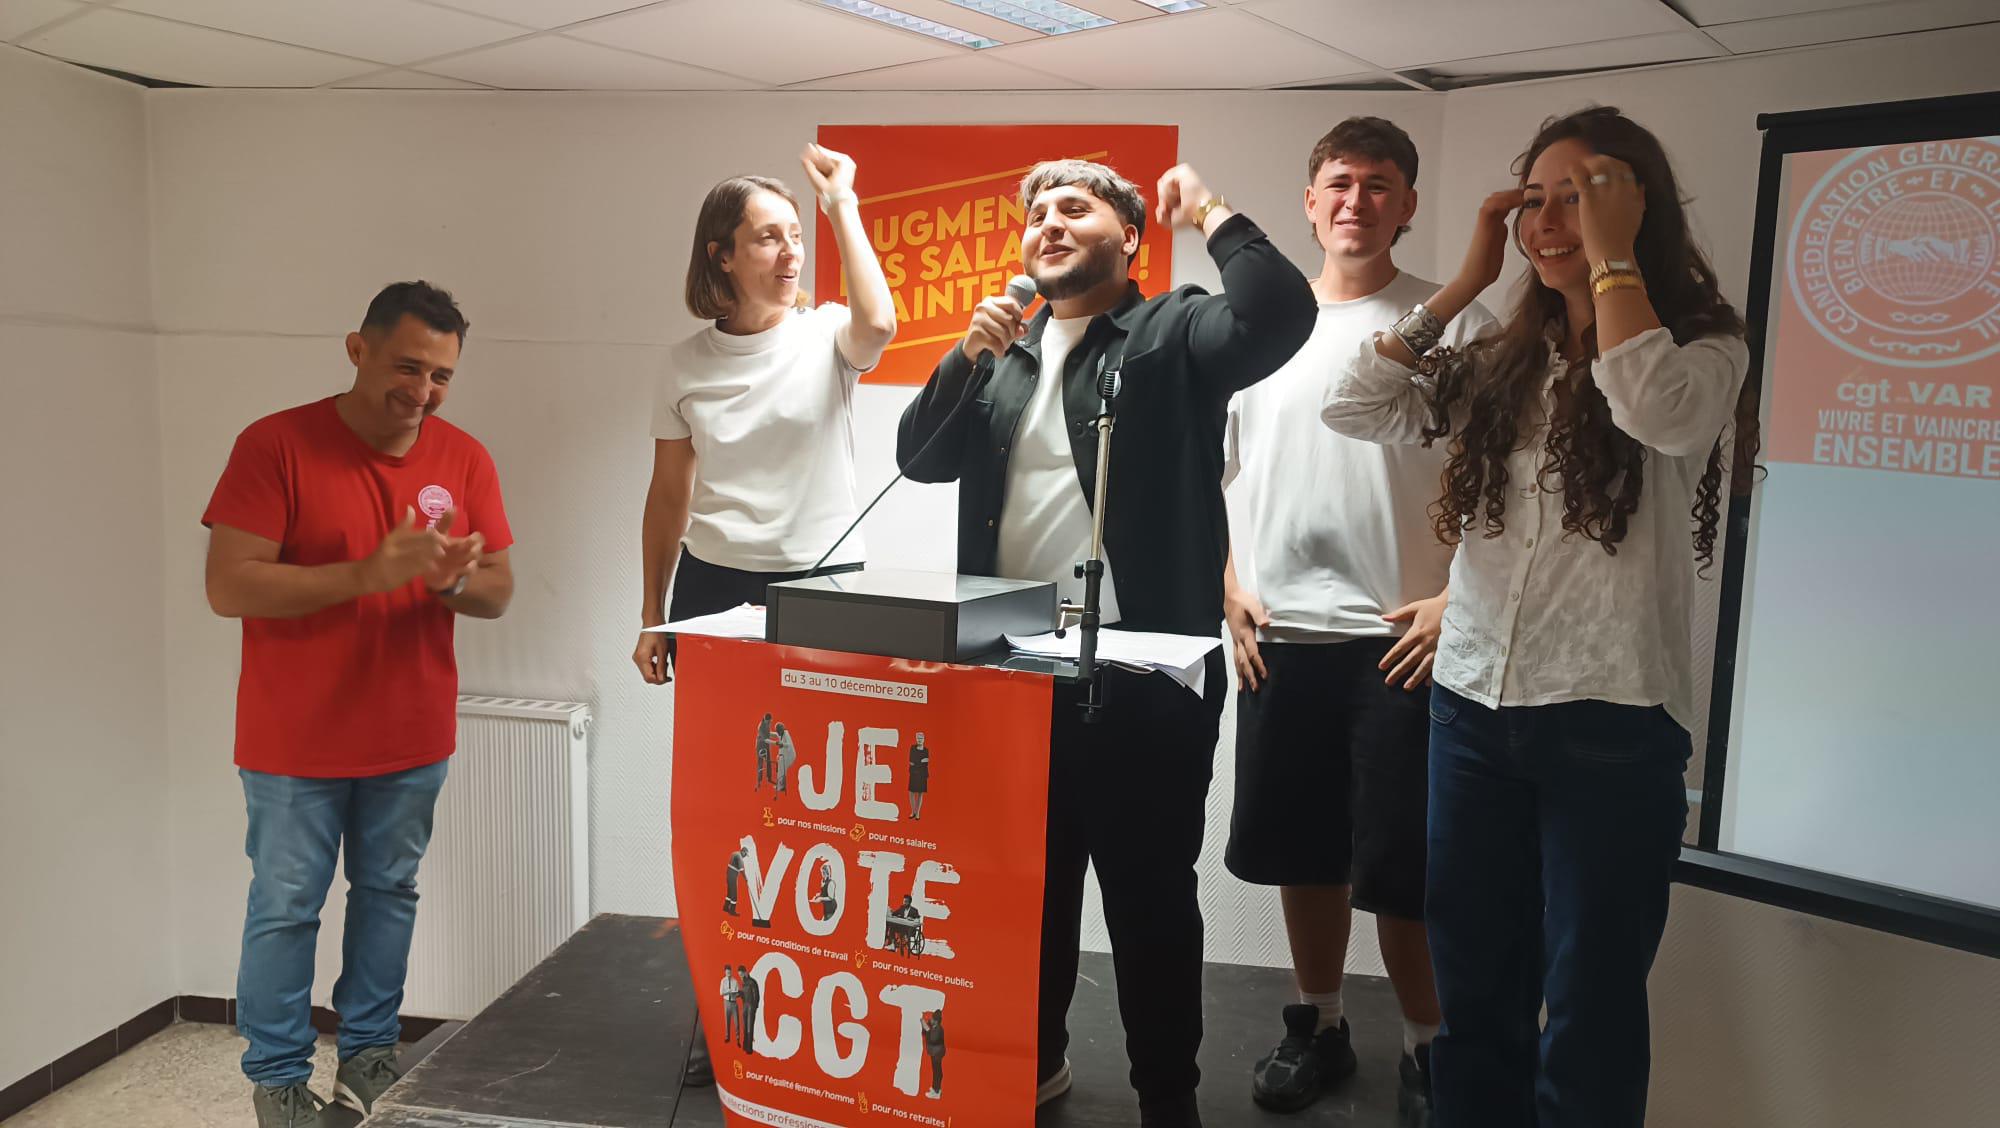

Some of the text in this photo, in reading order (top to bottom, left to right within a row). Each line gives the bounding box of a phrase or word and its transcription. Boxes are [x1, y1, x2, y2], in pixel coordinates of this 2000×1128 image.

[1899, 143, 2000, 177] GENER
[1930, 170, 1966, 190] ET
[873, 192, 1026, 252] UGMEN
[919, 230, 1022, 281] SALA
[1139, 244, 1149, 281] !
[1837, 378, 1993, 409] cgt VAR
[1818, 409, 2000, 441] VIVRE ET VAINCRE
[1813, 432, 2000, 477] ENSEMBLE
[784, 672, 924, 699] du 3 au 10 décembre 2026
[798, 720, 900, 822] JE
[777, 816, 846, 835] pour nos missions
[869, 832, 937, 850] pour nos salaires
[739, 834, 960, 960] VOTE
[737, 931, 848, 961] pour nos conditions de travail
[872, 960, 974, 989] pour nos services publics
[749, 952, 946, 1097] CGT
[746, 1071, 763, 1081] pour
[872, 1103, 892, 1114] pour
[893, 1108, 908, 1119] nos
[909, 1113, 945, 1128] retraites
